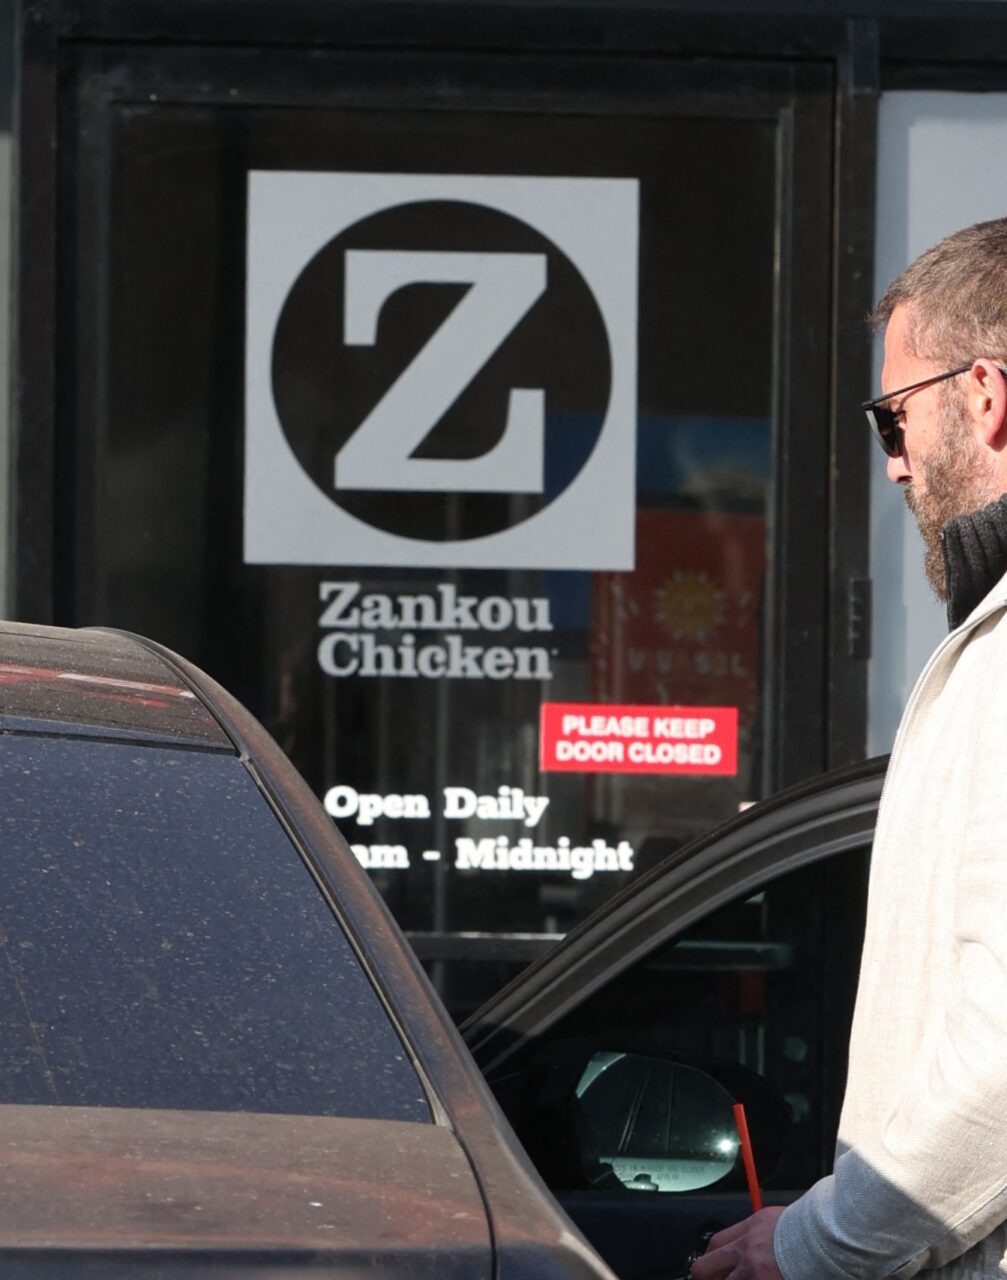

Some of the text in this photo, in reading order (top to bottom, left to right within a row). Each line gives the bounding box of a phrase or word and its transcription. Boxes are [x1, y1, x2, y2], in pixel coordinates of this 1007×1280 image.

[334, 249, 547, 493] Z
[319, 581, 553, 632] Zankou
[317, 631, 553, 680] Chicken
[562, 714, 716, 740] PLEASE KEEP
[555, 740, 722, 765] DOOR CLOSED
[324, 785, 549, 828] Open Daily
[455, 835, 634, 880] Midnight
